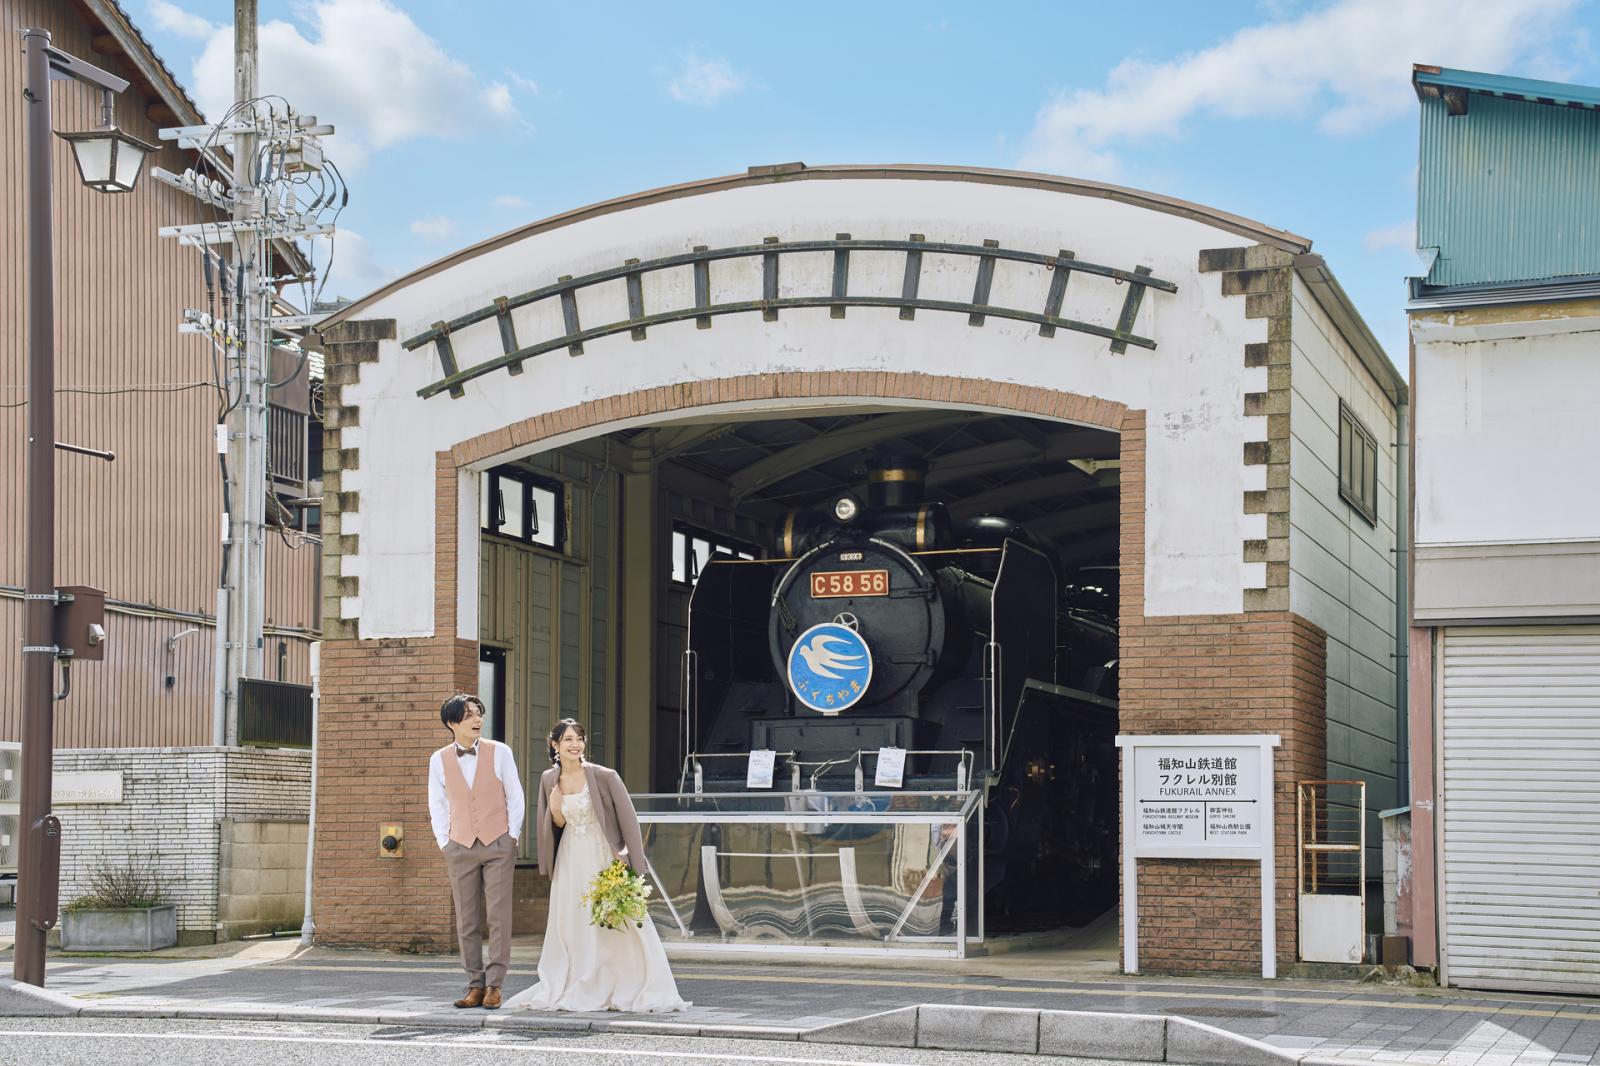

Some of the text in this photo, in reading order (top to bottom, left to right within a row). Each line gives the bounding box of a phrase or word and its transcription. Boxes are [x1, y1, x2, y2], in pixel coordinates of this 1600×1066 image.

[860, 574, 884, 592] 56
[1158, 757, 1238, 771] 福知山鉄道館
[1159, 773, 1238, 786] フクレル別館
[1159, 787, 1237, 796] FUKURAIL ANNEX
